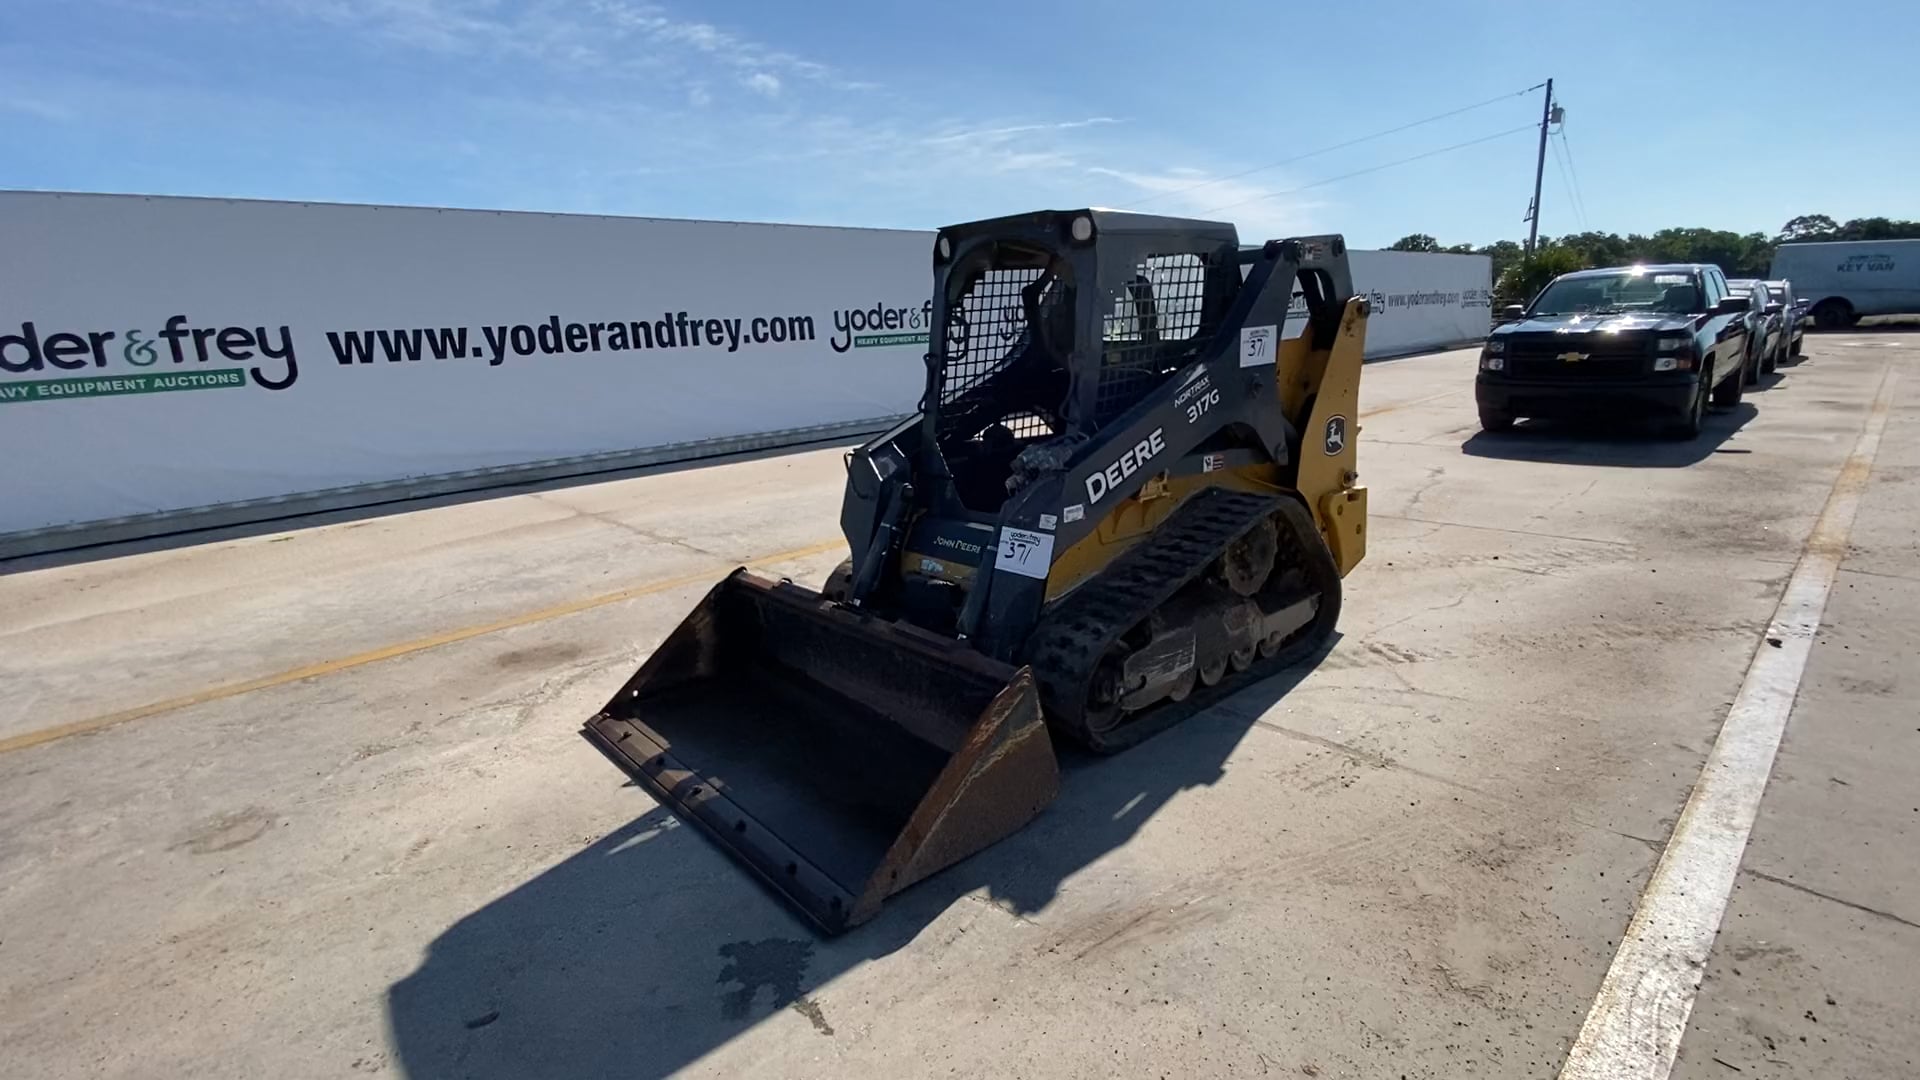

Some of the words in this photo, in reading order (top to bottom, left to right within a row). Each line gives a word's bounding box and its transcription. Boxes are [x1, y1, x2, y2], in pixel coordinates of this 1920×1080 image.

[1837, 263, 1863, 272] KEY
[1867, 261, 1895, 272] VAN
[325, 311, 816, 367] www.yoderandfrey.com
[830, 299, 932, 353] yoder&f
[37, 378, 147, 396] EQUIPMENT
[153, 373, 240, 389] AUCTIONS
[1174, 375, 1210, 408] NORTRAX
[1187, 388, 1220, 424] 317G
[1085, 427, 1166, 504] DEERE
[933, 535, 956, 548] JOHN
